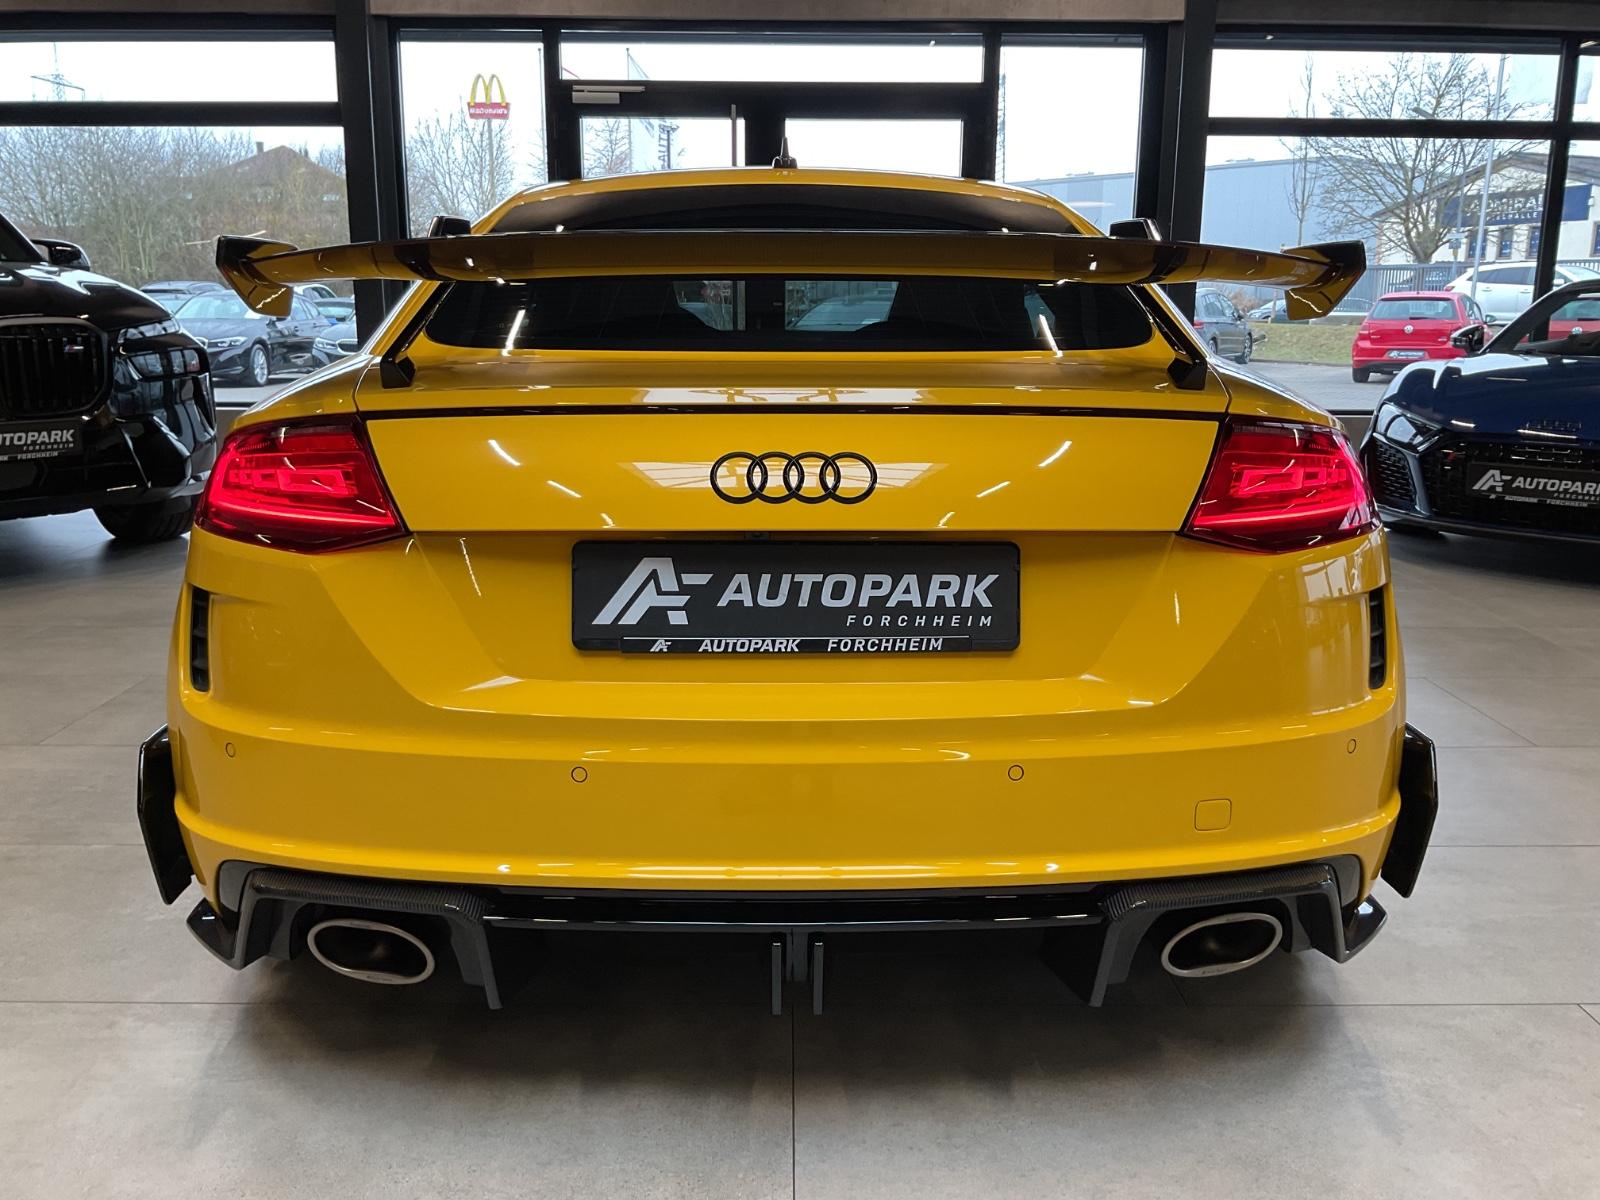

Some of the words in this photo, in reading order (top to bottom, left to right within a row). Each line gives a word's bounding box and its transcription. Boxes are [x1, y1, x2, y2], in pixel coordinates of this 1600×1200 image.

[0, 429, 75, 446] TOPARK
[716, 573, 1000, 608] AUTOPARK
[846, 615, 993, 627] FORCHHEIM
[698, 639, 800, 653] AUTOPARK
[827, 638, 944, 652] FORCHHEIM
